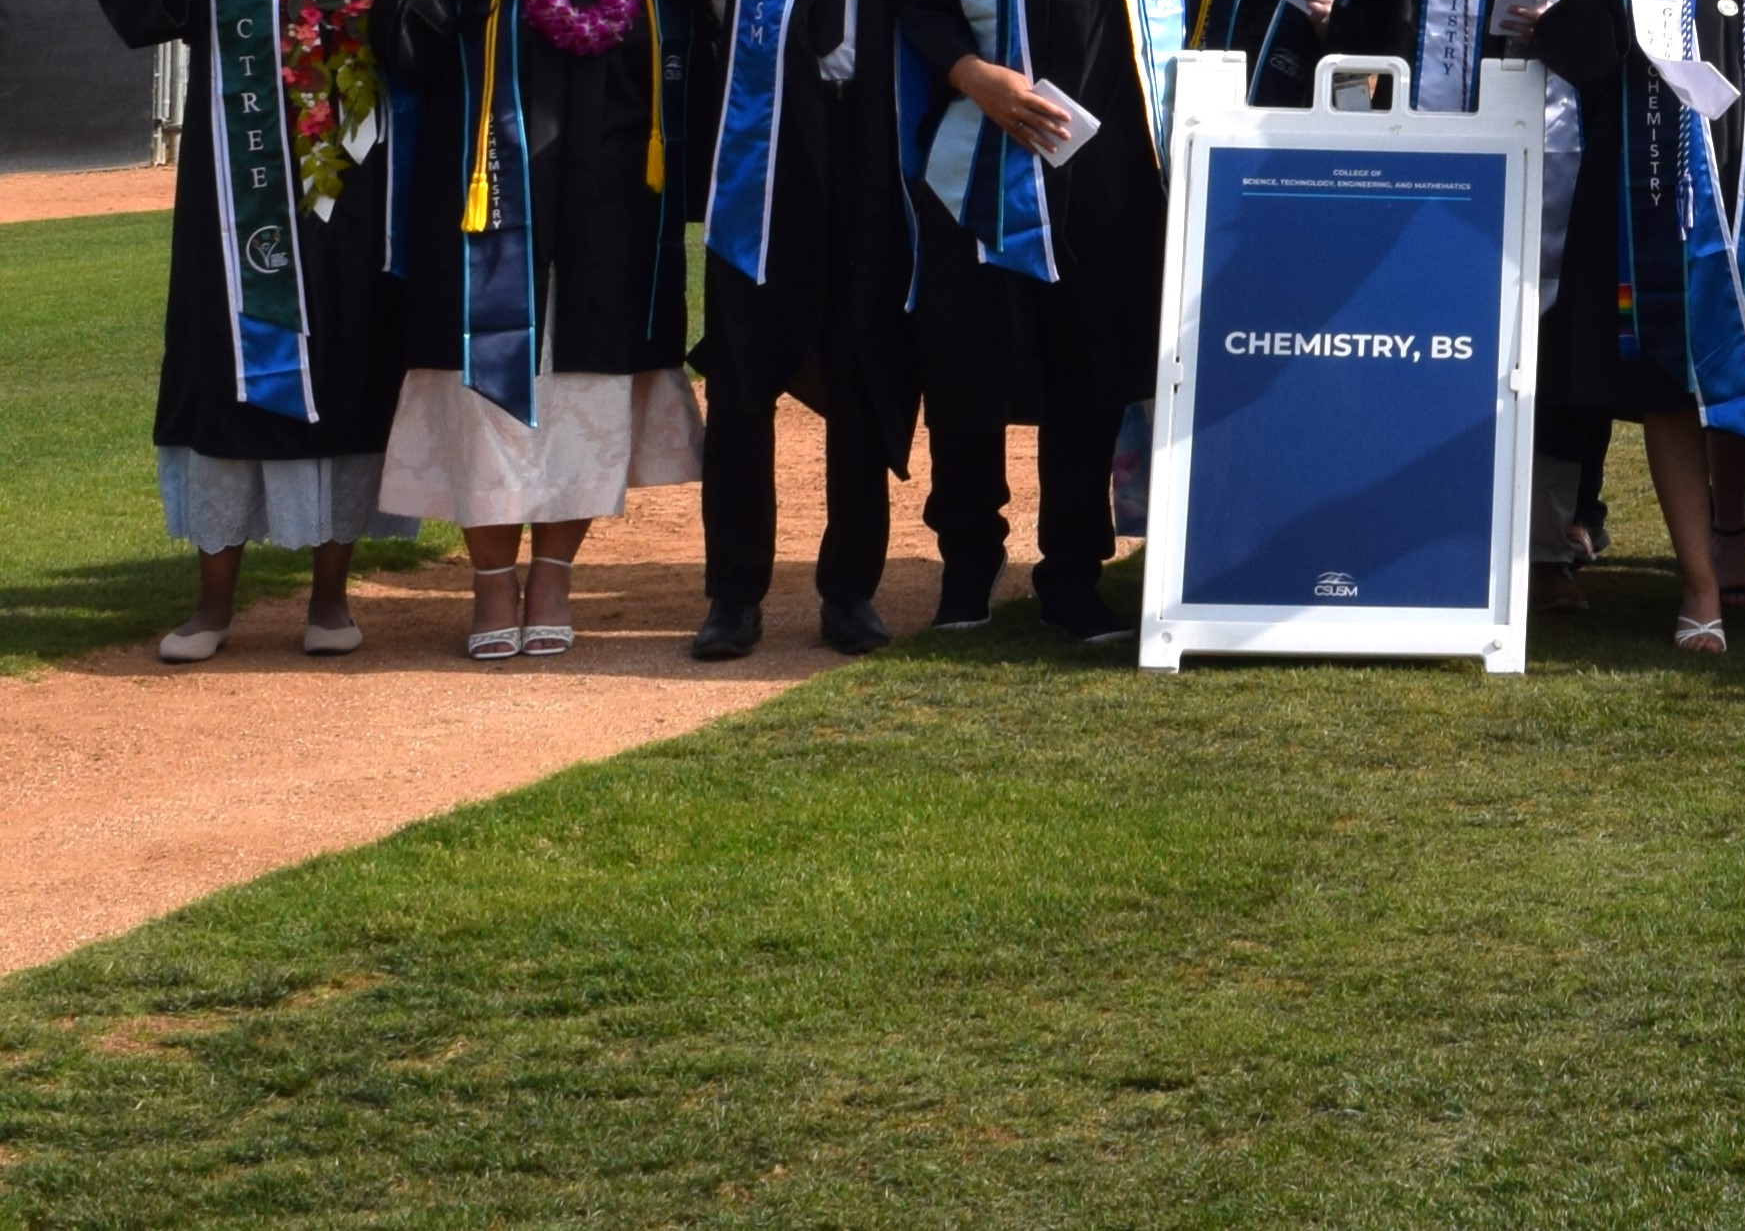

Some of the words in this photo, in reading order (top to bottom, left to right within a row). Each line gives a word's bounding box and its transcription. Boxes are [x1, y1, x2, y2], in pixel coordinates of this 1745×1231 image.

[237, 19, 268, 189] CTREE
[1333, 169, 1369, 177] COLLEGE
[1242, 177, 1279, 186] SCIENCE,
[1281, 178, 1336, 188] TECHNOLOGY,
[1337, 180, 1392, 189] ENGINEERING,
[1395, 181, 1413, 189] AND
[1414, 181, 1470, 190] MATHEMATICS
[1225, 331, 1420, 363] CHEMISTRY,
[1431, 335, 1473, 359] BS
[1314, 585, 1358, 597] CSUSM
